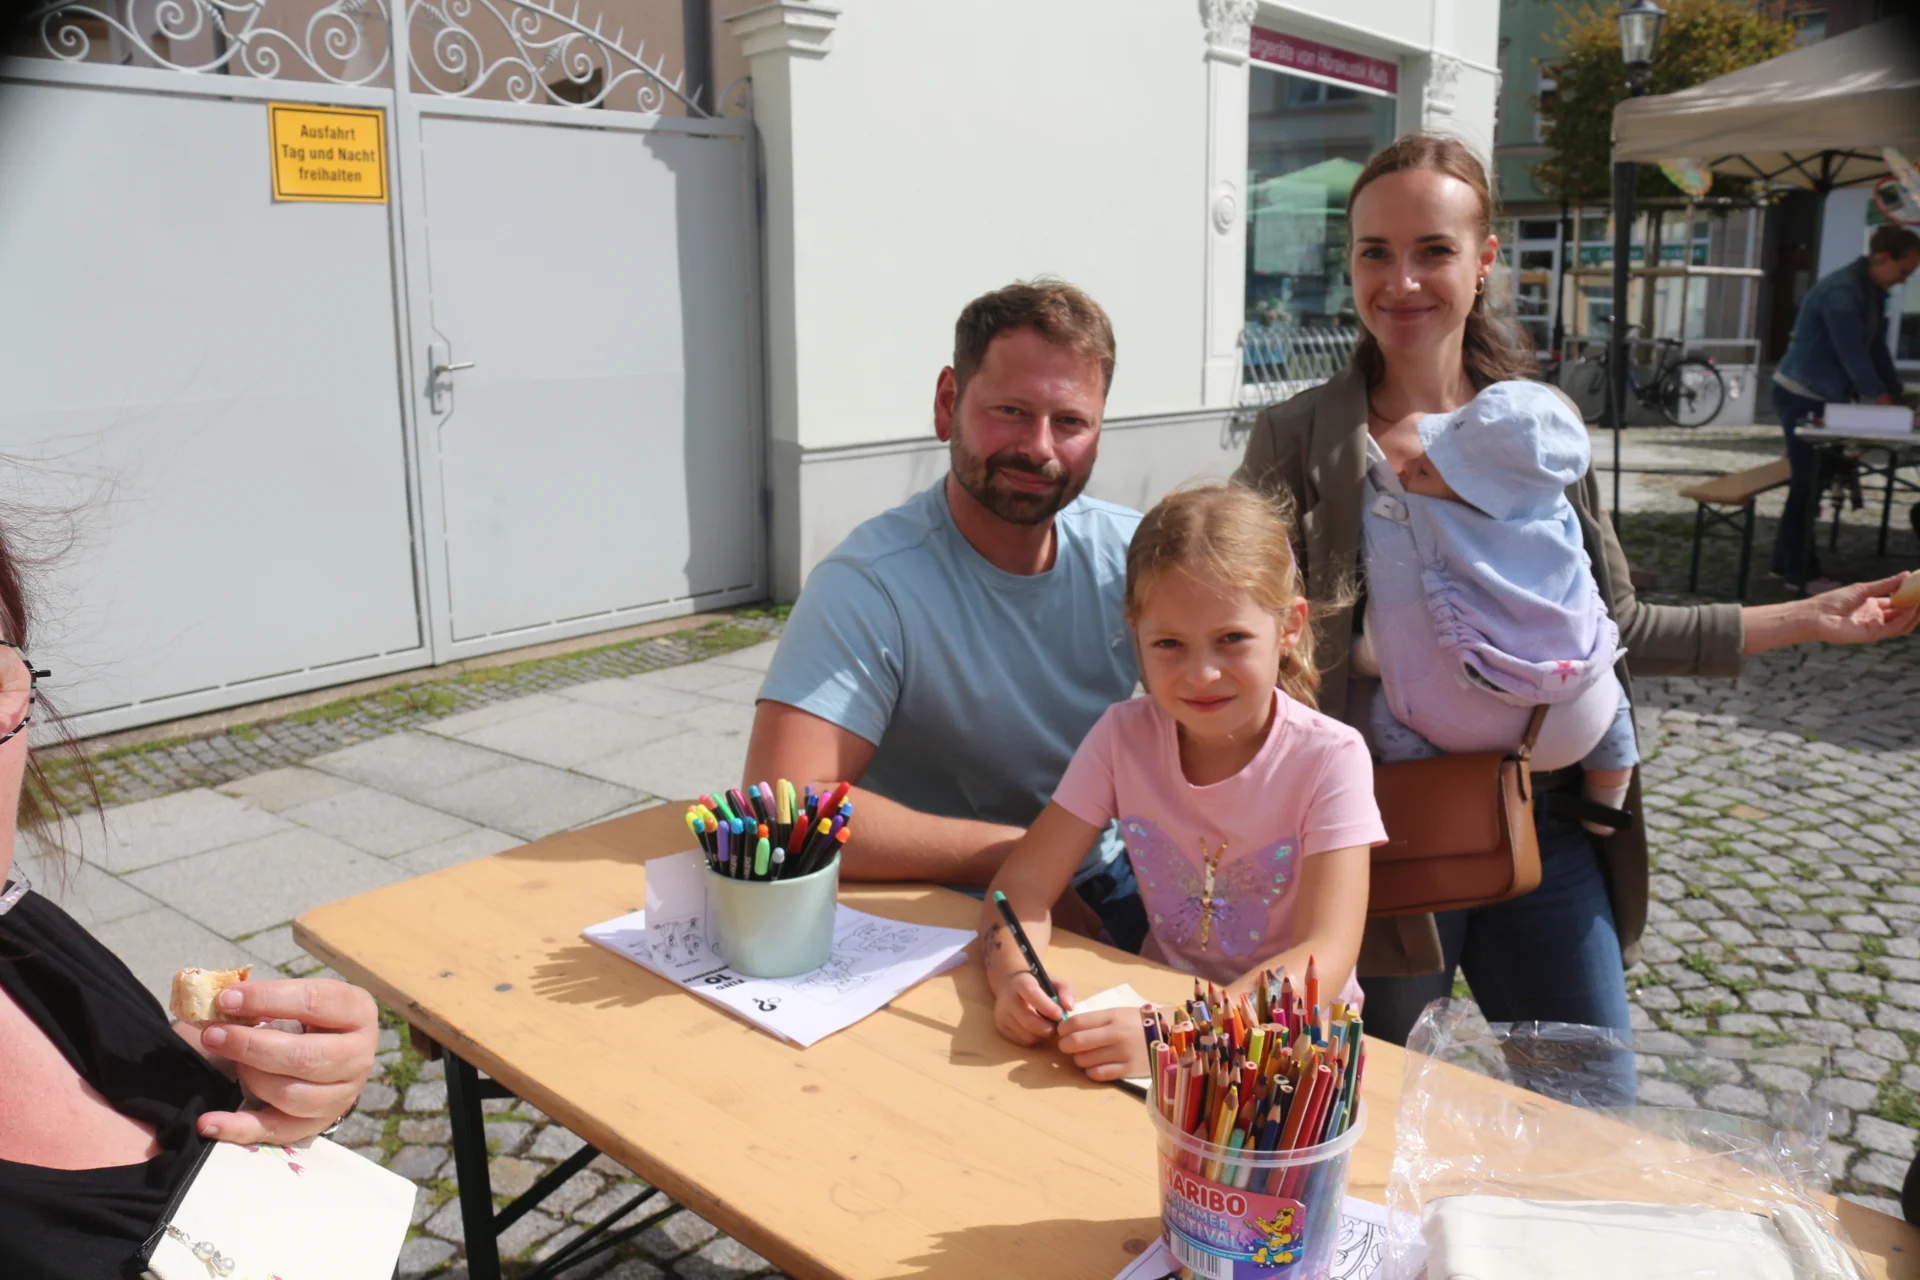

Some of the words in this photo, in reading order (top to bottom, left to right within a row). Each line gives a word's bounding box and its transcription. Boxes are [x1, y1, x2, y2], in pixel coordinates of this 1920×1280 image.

[1250, 32, 1294, 61] örgeräte
[300, 124, 356, 140] Ausfahrt
[281, 144, 305, 162] Tag
[309, 147, 334, 160] und
[338, 147, 375, 162] Nacht
[299, 166, 362, 182] freihalten
[704, 973, 732, 985] 10
[715, 979, 746, 991] FIND
[1171, 1195, 1231, 1232] SUMMER
[1165, 1200, 1243, 1250] FESTIVAL
